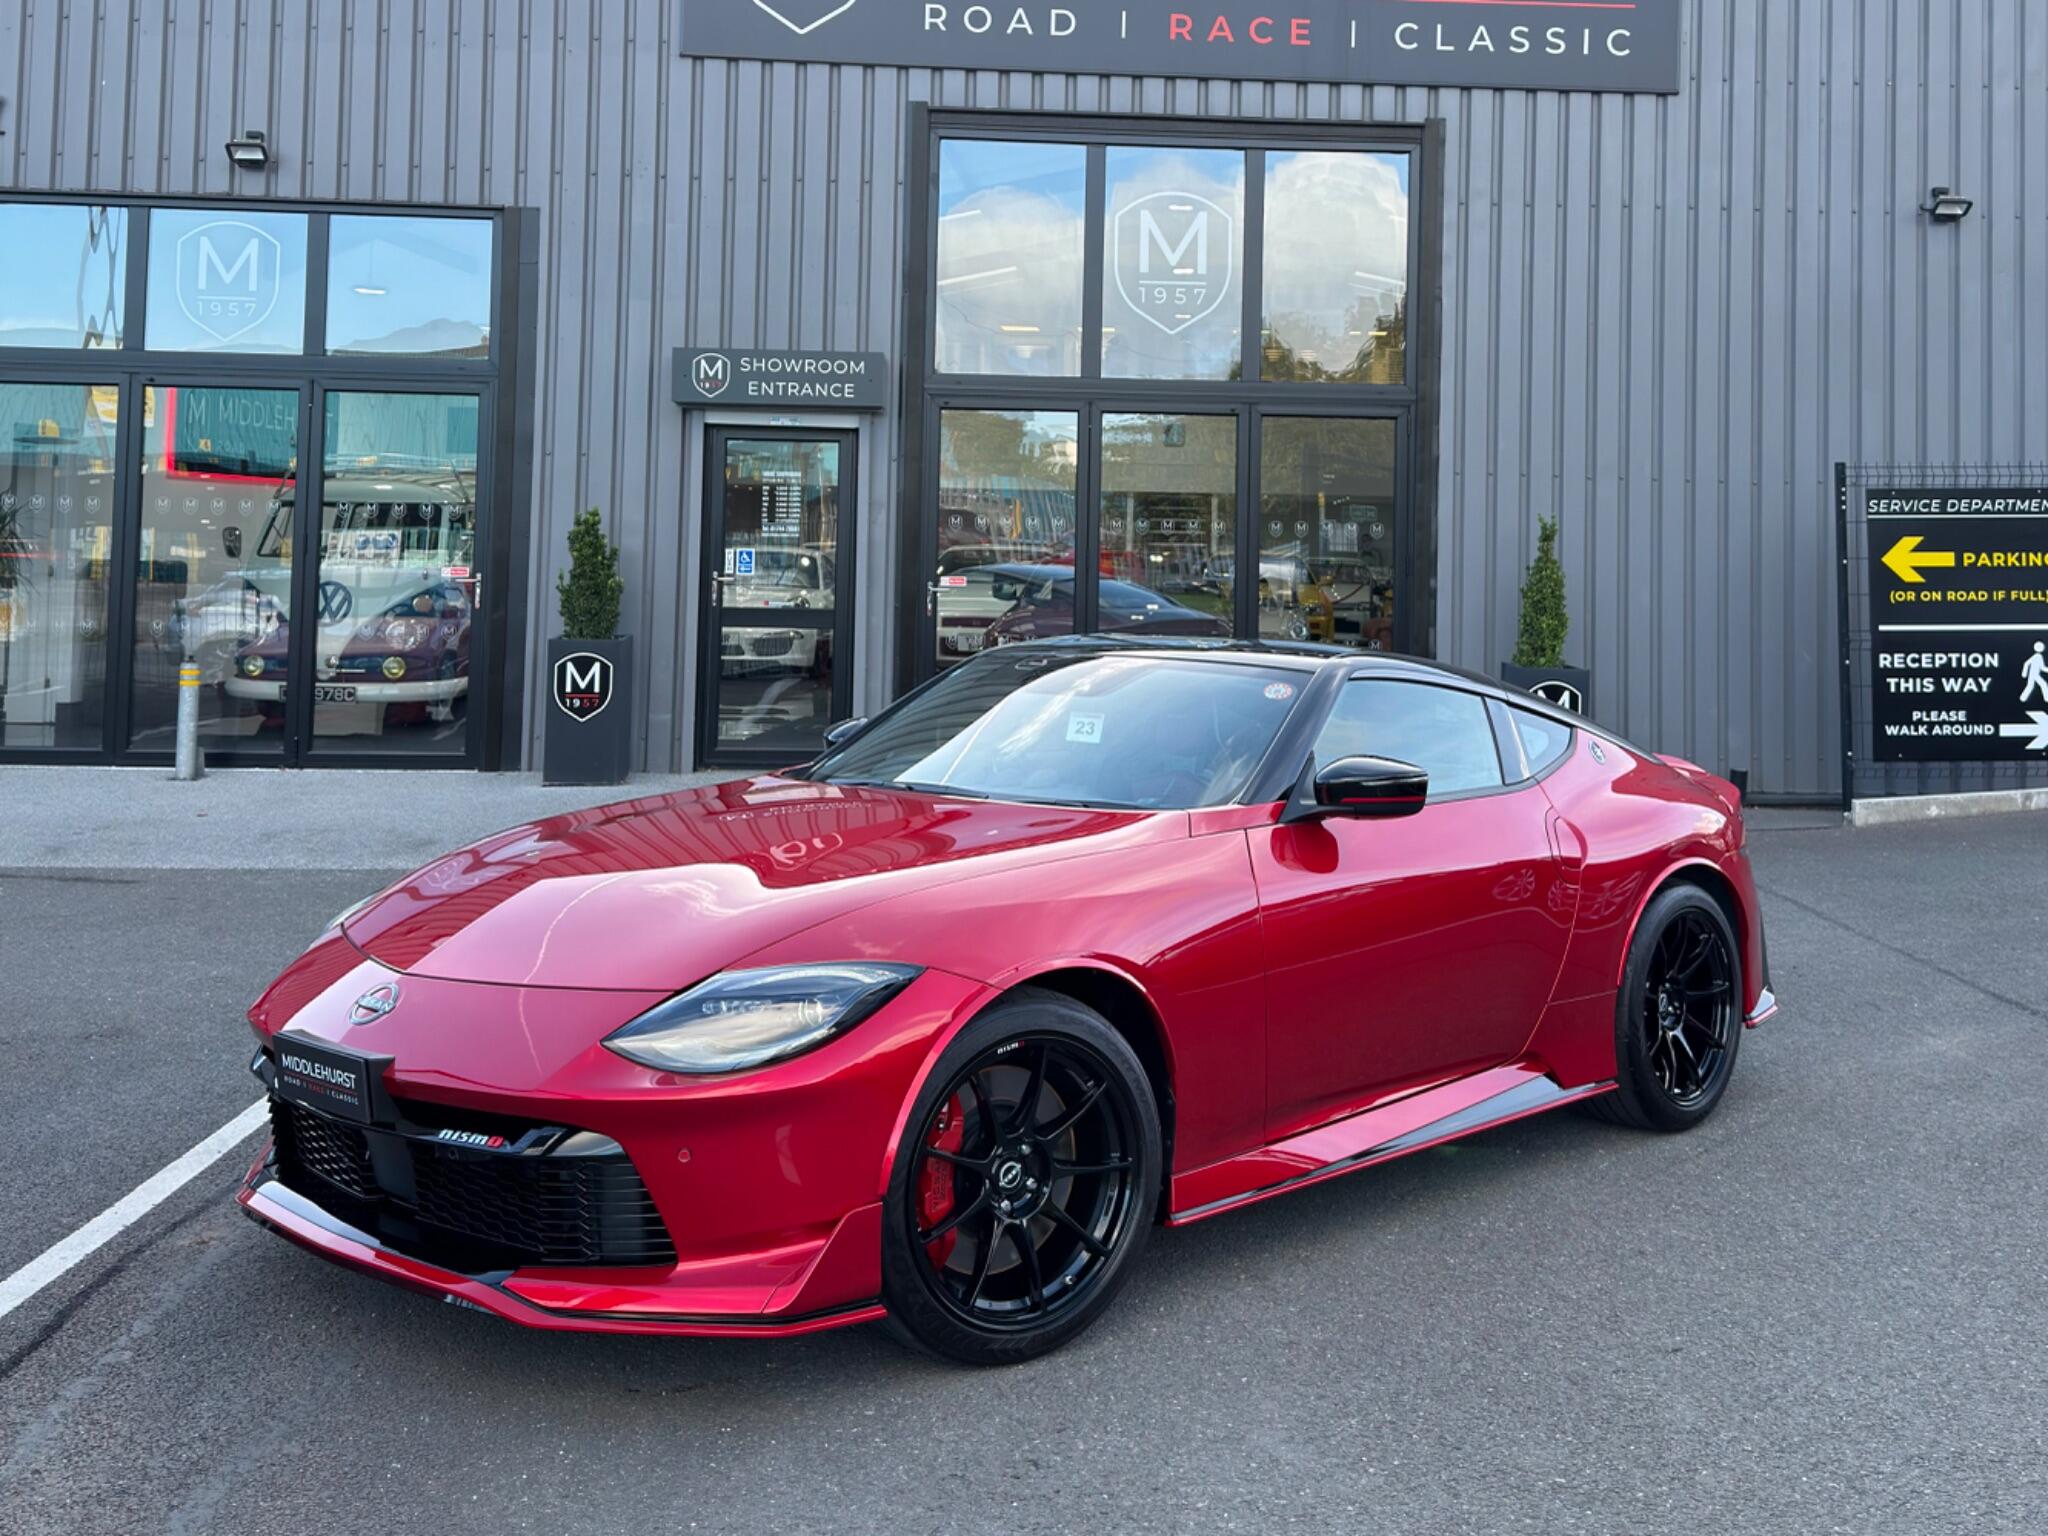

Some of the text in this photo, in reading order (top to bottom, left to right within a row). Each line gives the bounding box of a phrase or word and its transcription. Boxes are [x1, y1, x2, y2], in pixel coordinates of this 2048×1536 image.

[923, 3, 1076, 36] ROAD
[1168, 12, 1311, 46] RACE
[1394, 22, 1632, 57] CLASSIC
[1139, 209, 1207, 274] M
[198, 235, 259, 292] M
[1138, 286, 1207, 305] 1957
[197, 301, 257, 317] 1957
[740, 356, 866, 375] SHOWROOM
[748, 380, 855, 398] ENTRANCE
[1868, 499, 1941, 513] SERVICE
[1889, 590, 1916, 604] (OR
[1920, 590, 1942, 602] ON
[1947, 590, 1988, 602] ROAD
[1993, 590, 2006, 602] IF
[1879, 653, 1999, 669] RECEPTION
[565, 661, 601, 693] M
[1886, 677, 1992, 693] THIS WAY
[1912, 710, 1967, 722] PLEASE
[1074, 720, 1096, 735] 23
[1885, 724, 1995, 736] WALK AROUND
[281, 1053, 356, 1090] MIDDLEHURST
